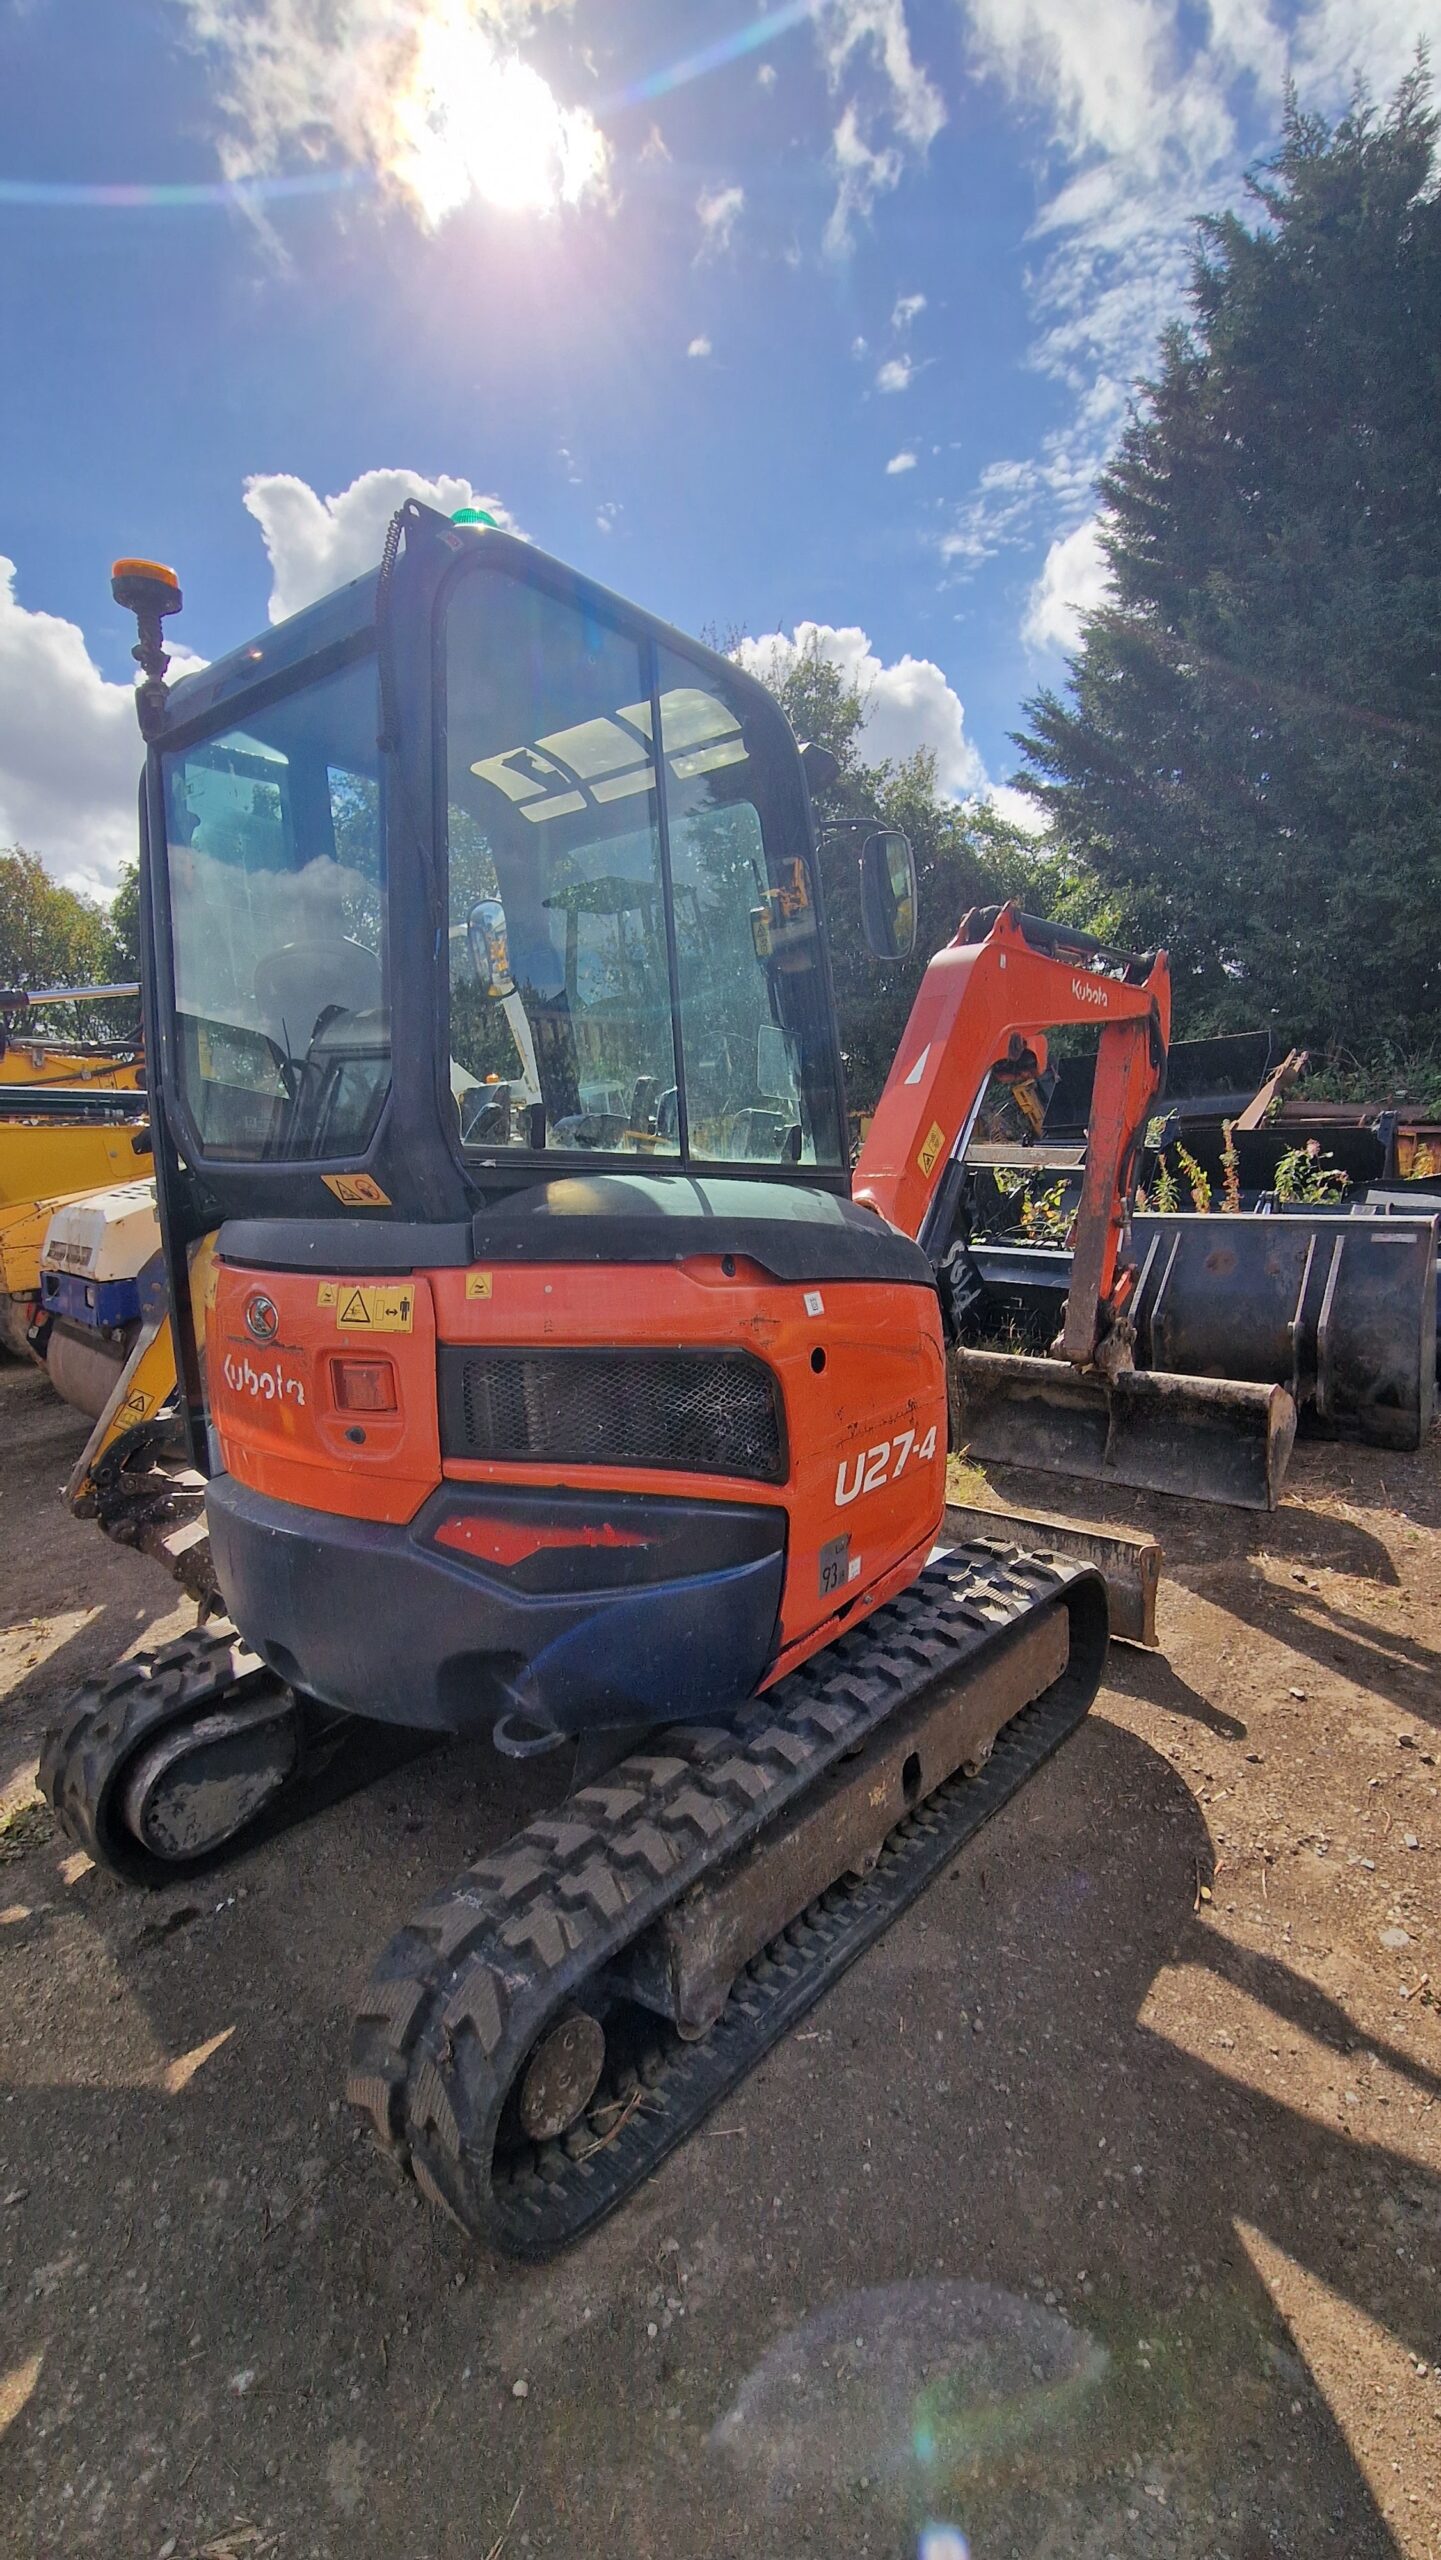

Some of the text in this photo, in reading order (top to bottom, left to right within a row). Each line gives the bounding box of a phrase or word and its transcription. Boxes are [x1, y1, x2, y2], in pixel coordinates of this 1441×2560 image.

[1072, 977, 1108, 1008] Kubota
[834, 1425, 938, 1507] U27-4
[822, 1562, 838, 1592] 93
